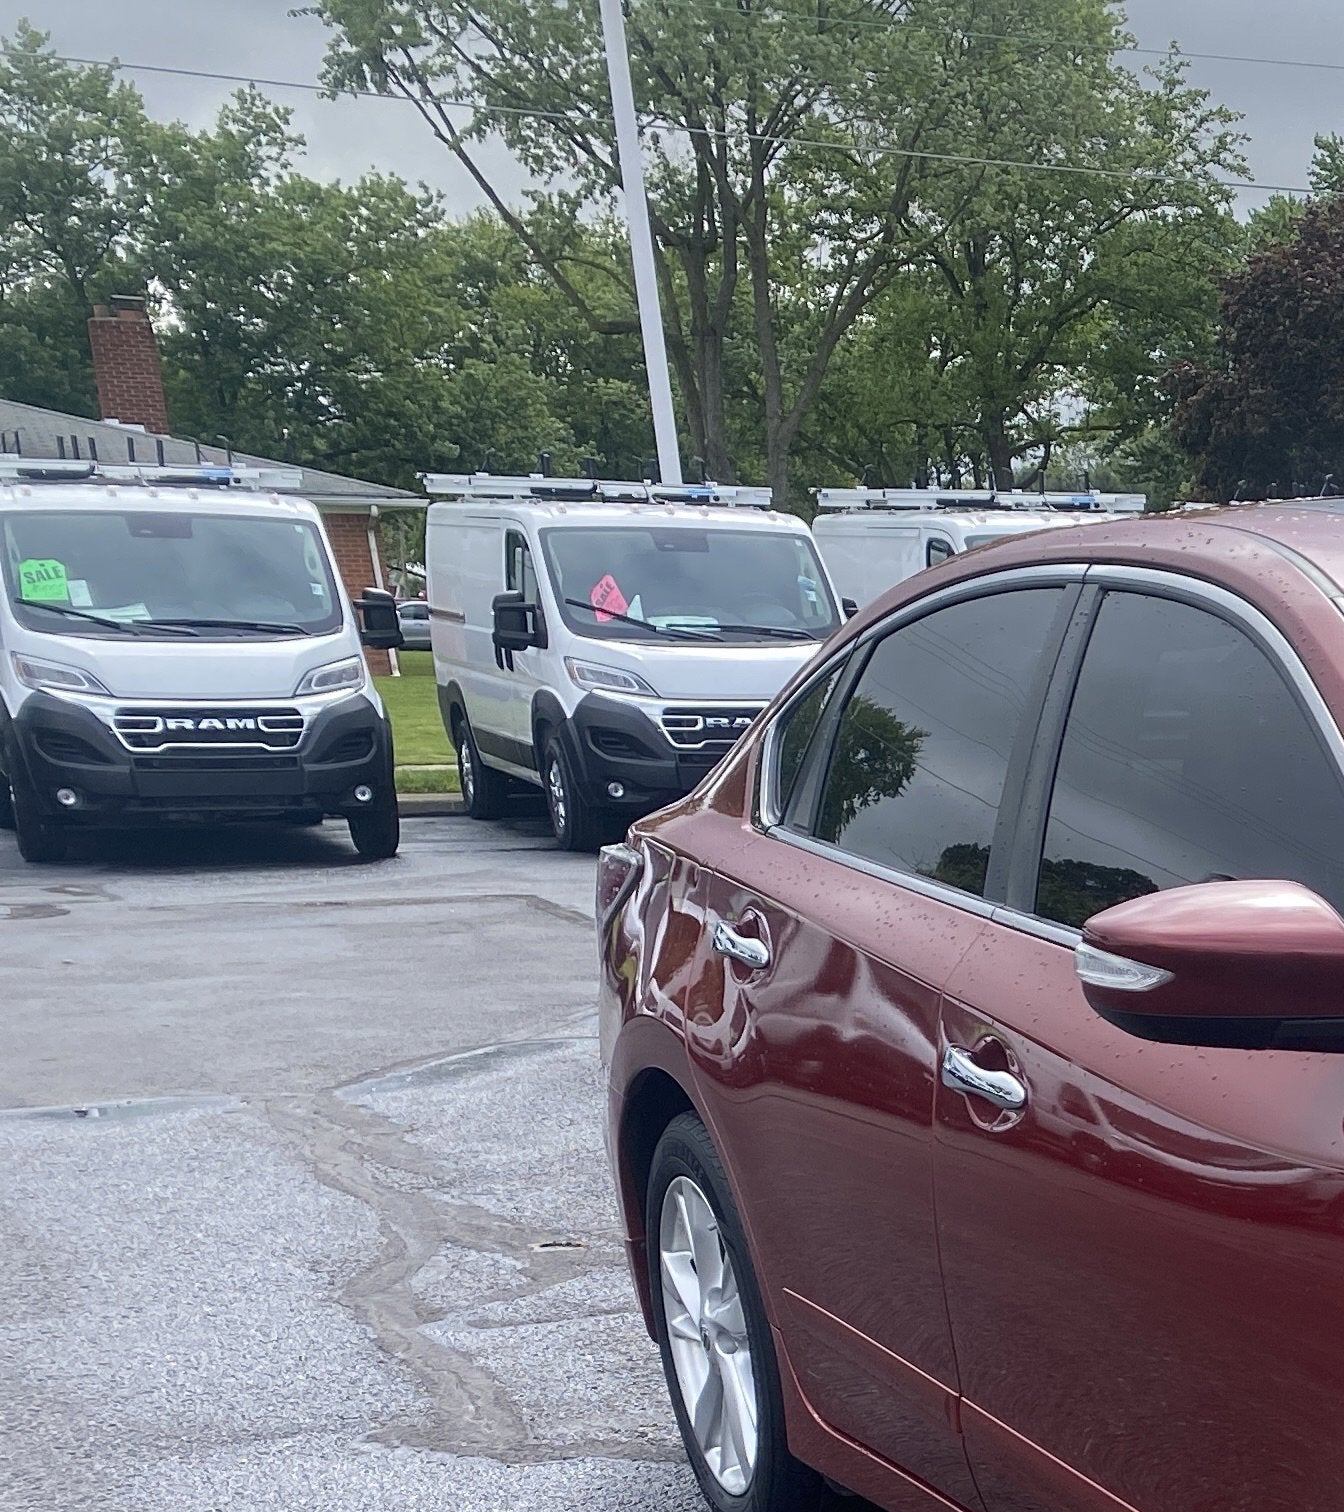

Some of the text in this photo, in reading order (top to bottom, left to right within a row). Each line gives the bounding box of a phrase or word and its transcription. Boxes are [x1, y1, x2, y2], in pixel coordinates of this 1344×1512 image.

[23, 565, 63, 585] SALE
[165, 717, 255, 730] RAM
[705, 717, 752, 728] RA
